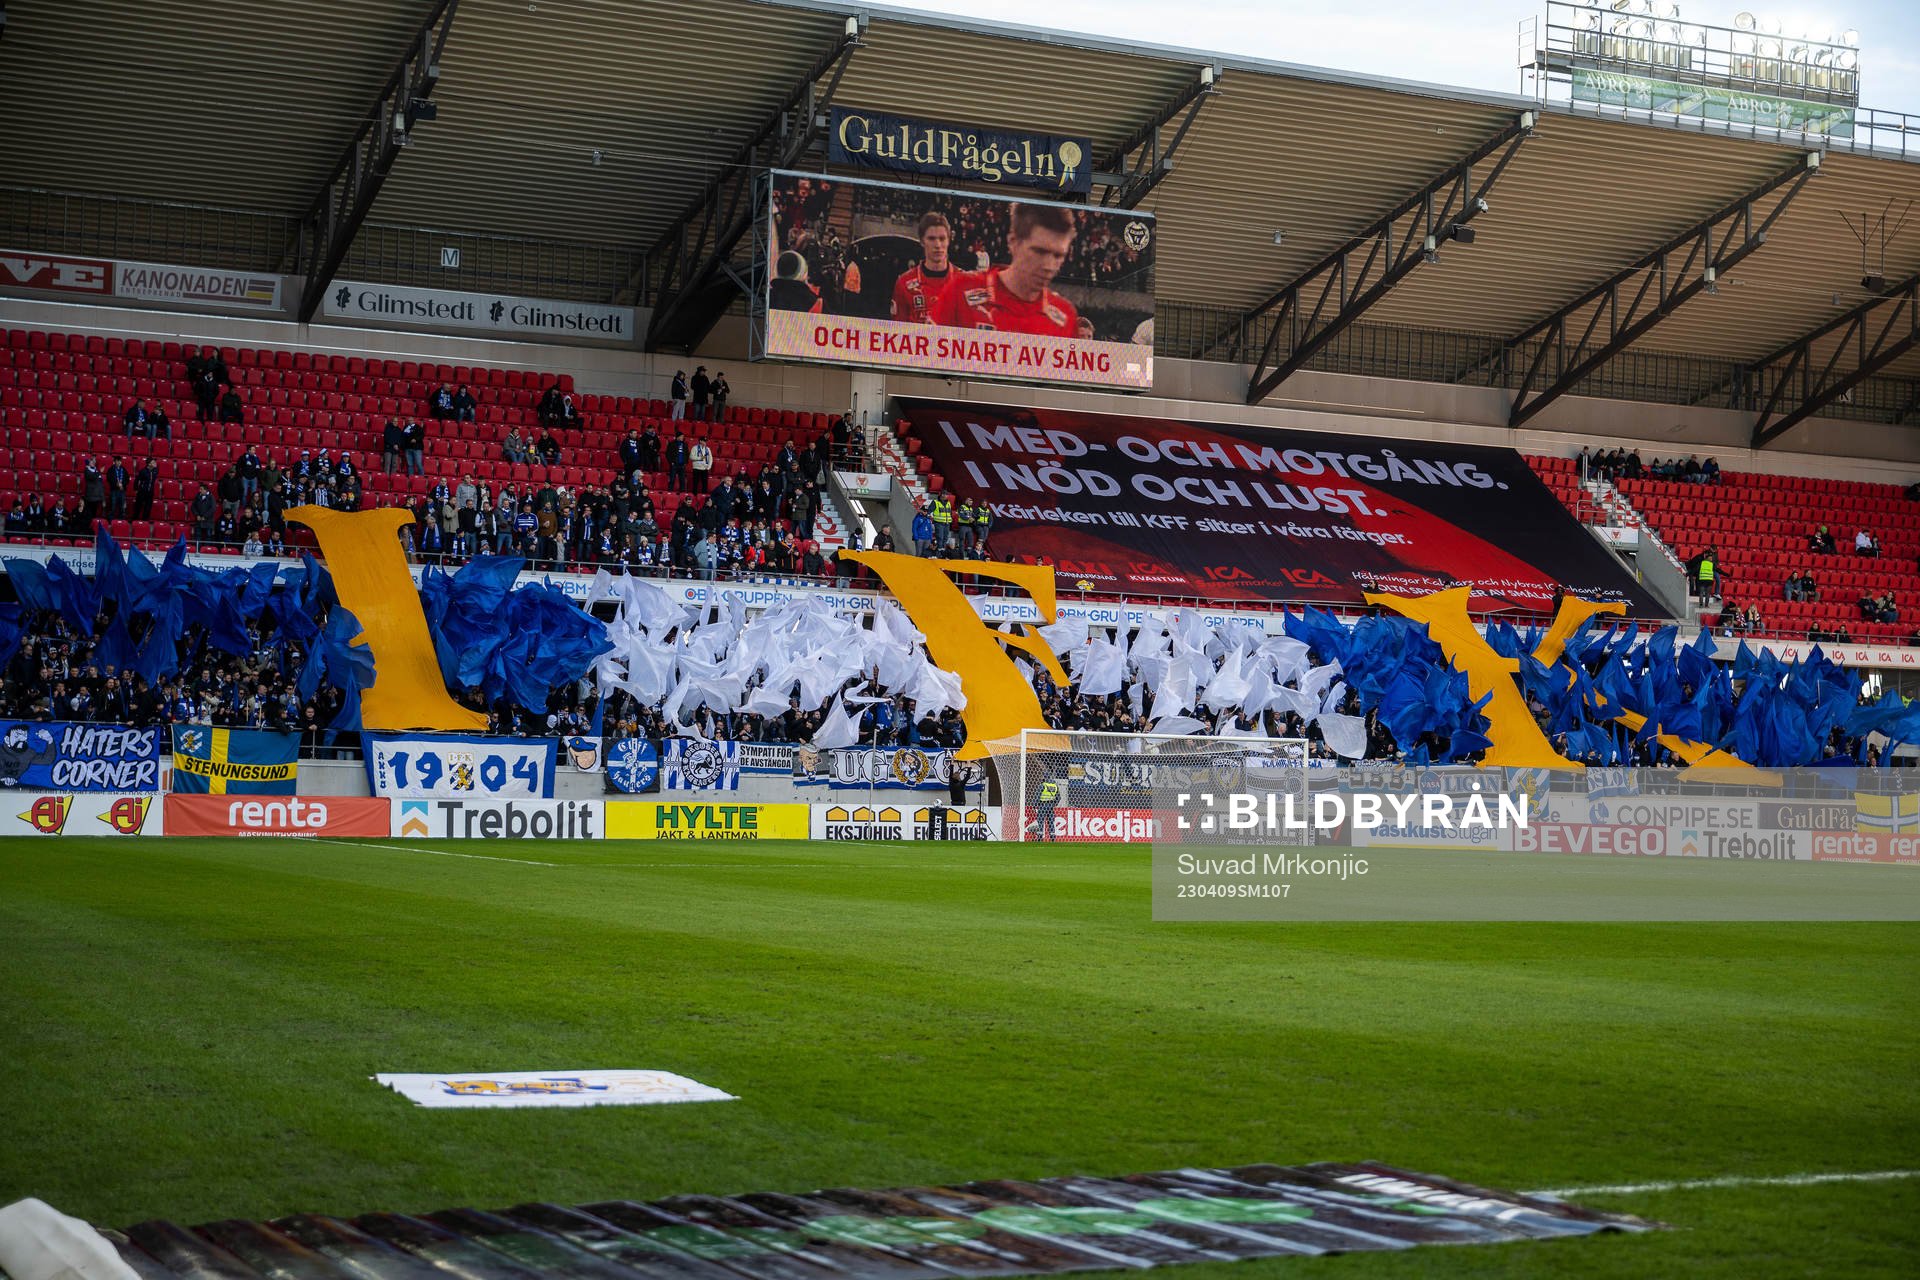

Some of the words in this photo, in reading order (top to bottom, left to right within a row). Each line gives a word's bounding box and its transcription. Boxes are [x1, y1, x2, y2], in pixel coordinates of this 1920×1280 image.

[839, 114, 1057, 182] GuldFågeln
[442, 249, 459, 267] M
[122, 268, 247, 297] KANONADEN
[358, 289, 475, 321] Glimstedt
[511, 305, 623, 335] Glimstedt
[814, 326, 860, 350] OCH
[869, 331, 929, 356] EKAR
[937, 338, 1012, 364] SNART
[1017, 345, 1047, 366] AV
[1053, 344, 1111, 373] SÅNG
[938, 421, 965, 448] I
[966, 422, 1108, 458] MED-
[1117, 435, 1236, 469] OCH
[1234, 444, 1509, 490] MOTGÅNG.
[963, 460, 990, 488] I
[996, 459, 1121, 498] NÖD
[1131, 473, 1245, 507] OCH
[1252, 481, 1388, 518] LUST.
[991, 502, 1106, 526] Kärleken
[1108, 509, 1141, 528] till
[1143, 513, 1188, 531] KFF
[1199, 517, 1256, 536] sitter
[1262, 520, 1272, 537] i
[1273, 521, 1331, 540] våra
[1331, 525, 1413, 547] färger.
[1129, 575, 1186, 583] KVANTUM
[1202, 566, 1255, 580] ICA
[1280, 567, 1338, 584] ICA
[1352, 571, 1420, 586] Hälsningar
[1478, 578, 1499, 587] och
[1501, 578, 1544, 590] Nybros
[1832, 650, 1845, 660] ICA
[1855, 651, 1869, 661] ICA
[1878, 652, 1892, 662] ICA
[1901, 653, 1915, 663] ICA
[60, 725, 155, 758] HATERS
[740, 745, 776, 757] SYMPATI
[777, 745, 792, 758] FÖR
[185, 757, 289, 780] STENUNGSUND
[740, 757, 749, 766] DE
[52, 759, 156, 789] CORNER
[228, 797, 328, 827] renta
[438, 801, 594, 839] Trebolit
[656, 805, 758, 830] HYLTE
[1617, 805, 1754, 829] CONPIPE.SE
[656, 830, 684, 840] JAKT
[687, 830, 696, 839] &
[700, 830, 758, 840] LANTMAN
[825, 822, 902, 841] EKSJÖHUS
[934, 815, 943, 841] SELECT
[1515, 825, 1665, 856] BEVEGO
[1703, 830, 1796, 860] Trebolit
[1814, 833, 1878, 855] renta
